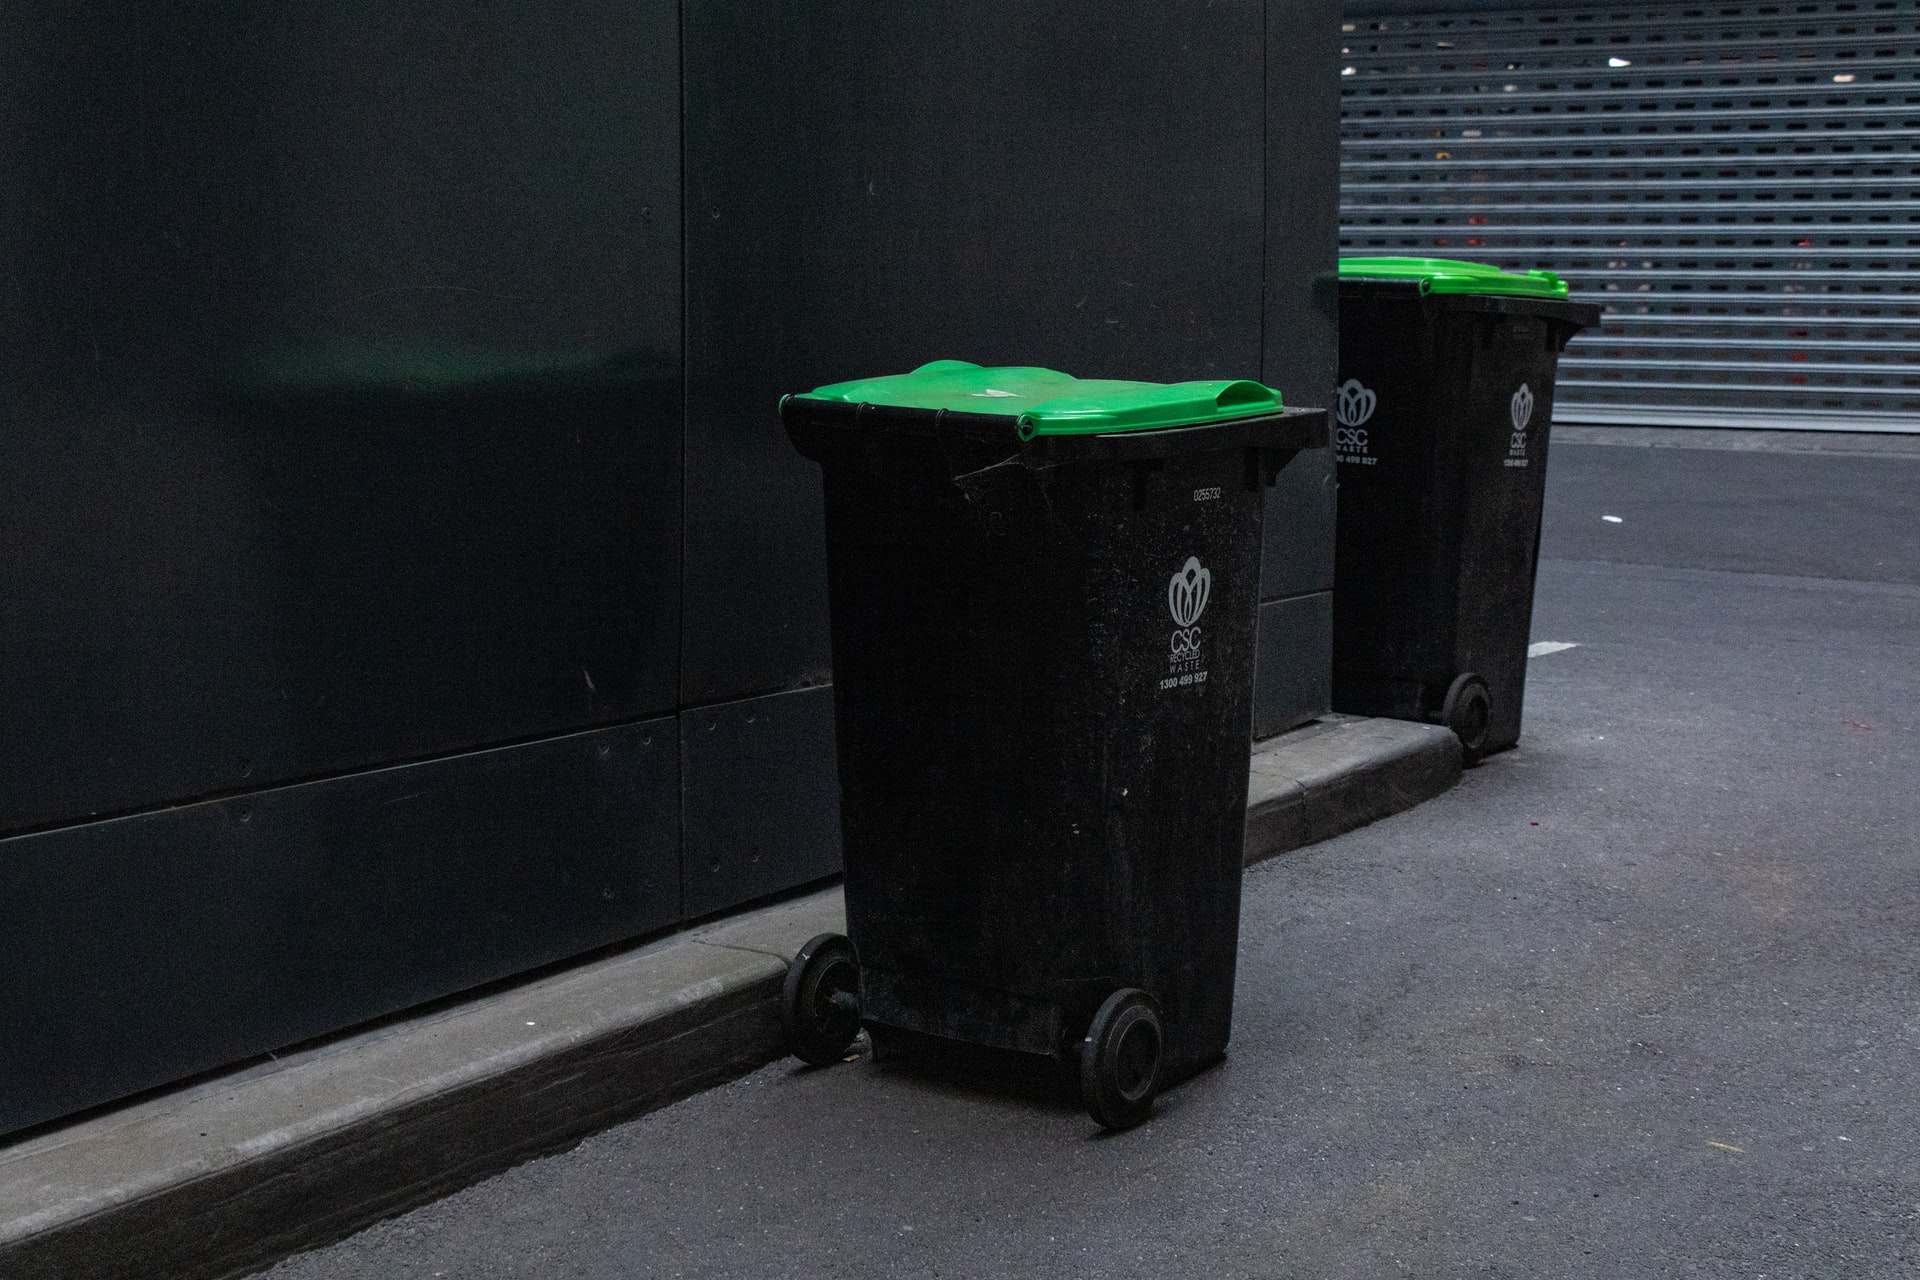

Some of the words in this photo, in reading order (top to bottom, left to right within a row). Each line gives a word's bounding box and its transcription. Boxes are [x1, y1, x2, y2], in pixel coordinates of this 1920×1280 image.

[1336, 428, 1368, 446] CSC
[1171, 626, 1201, 654] CSC
[1170, 650, 1200, 663] RECYCLED
[1170, 660, 1200, 673] WASTE
[1160, 677, 1178, 690] 1300
[1179, 674, 1193, 686] 499
[1194, 671, 1208, 683] 927
